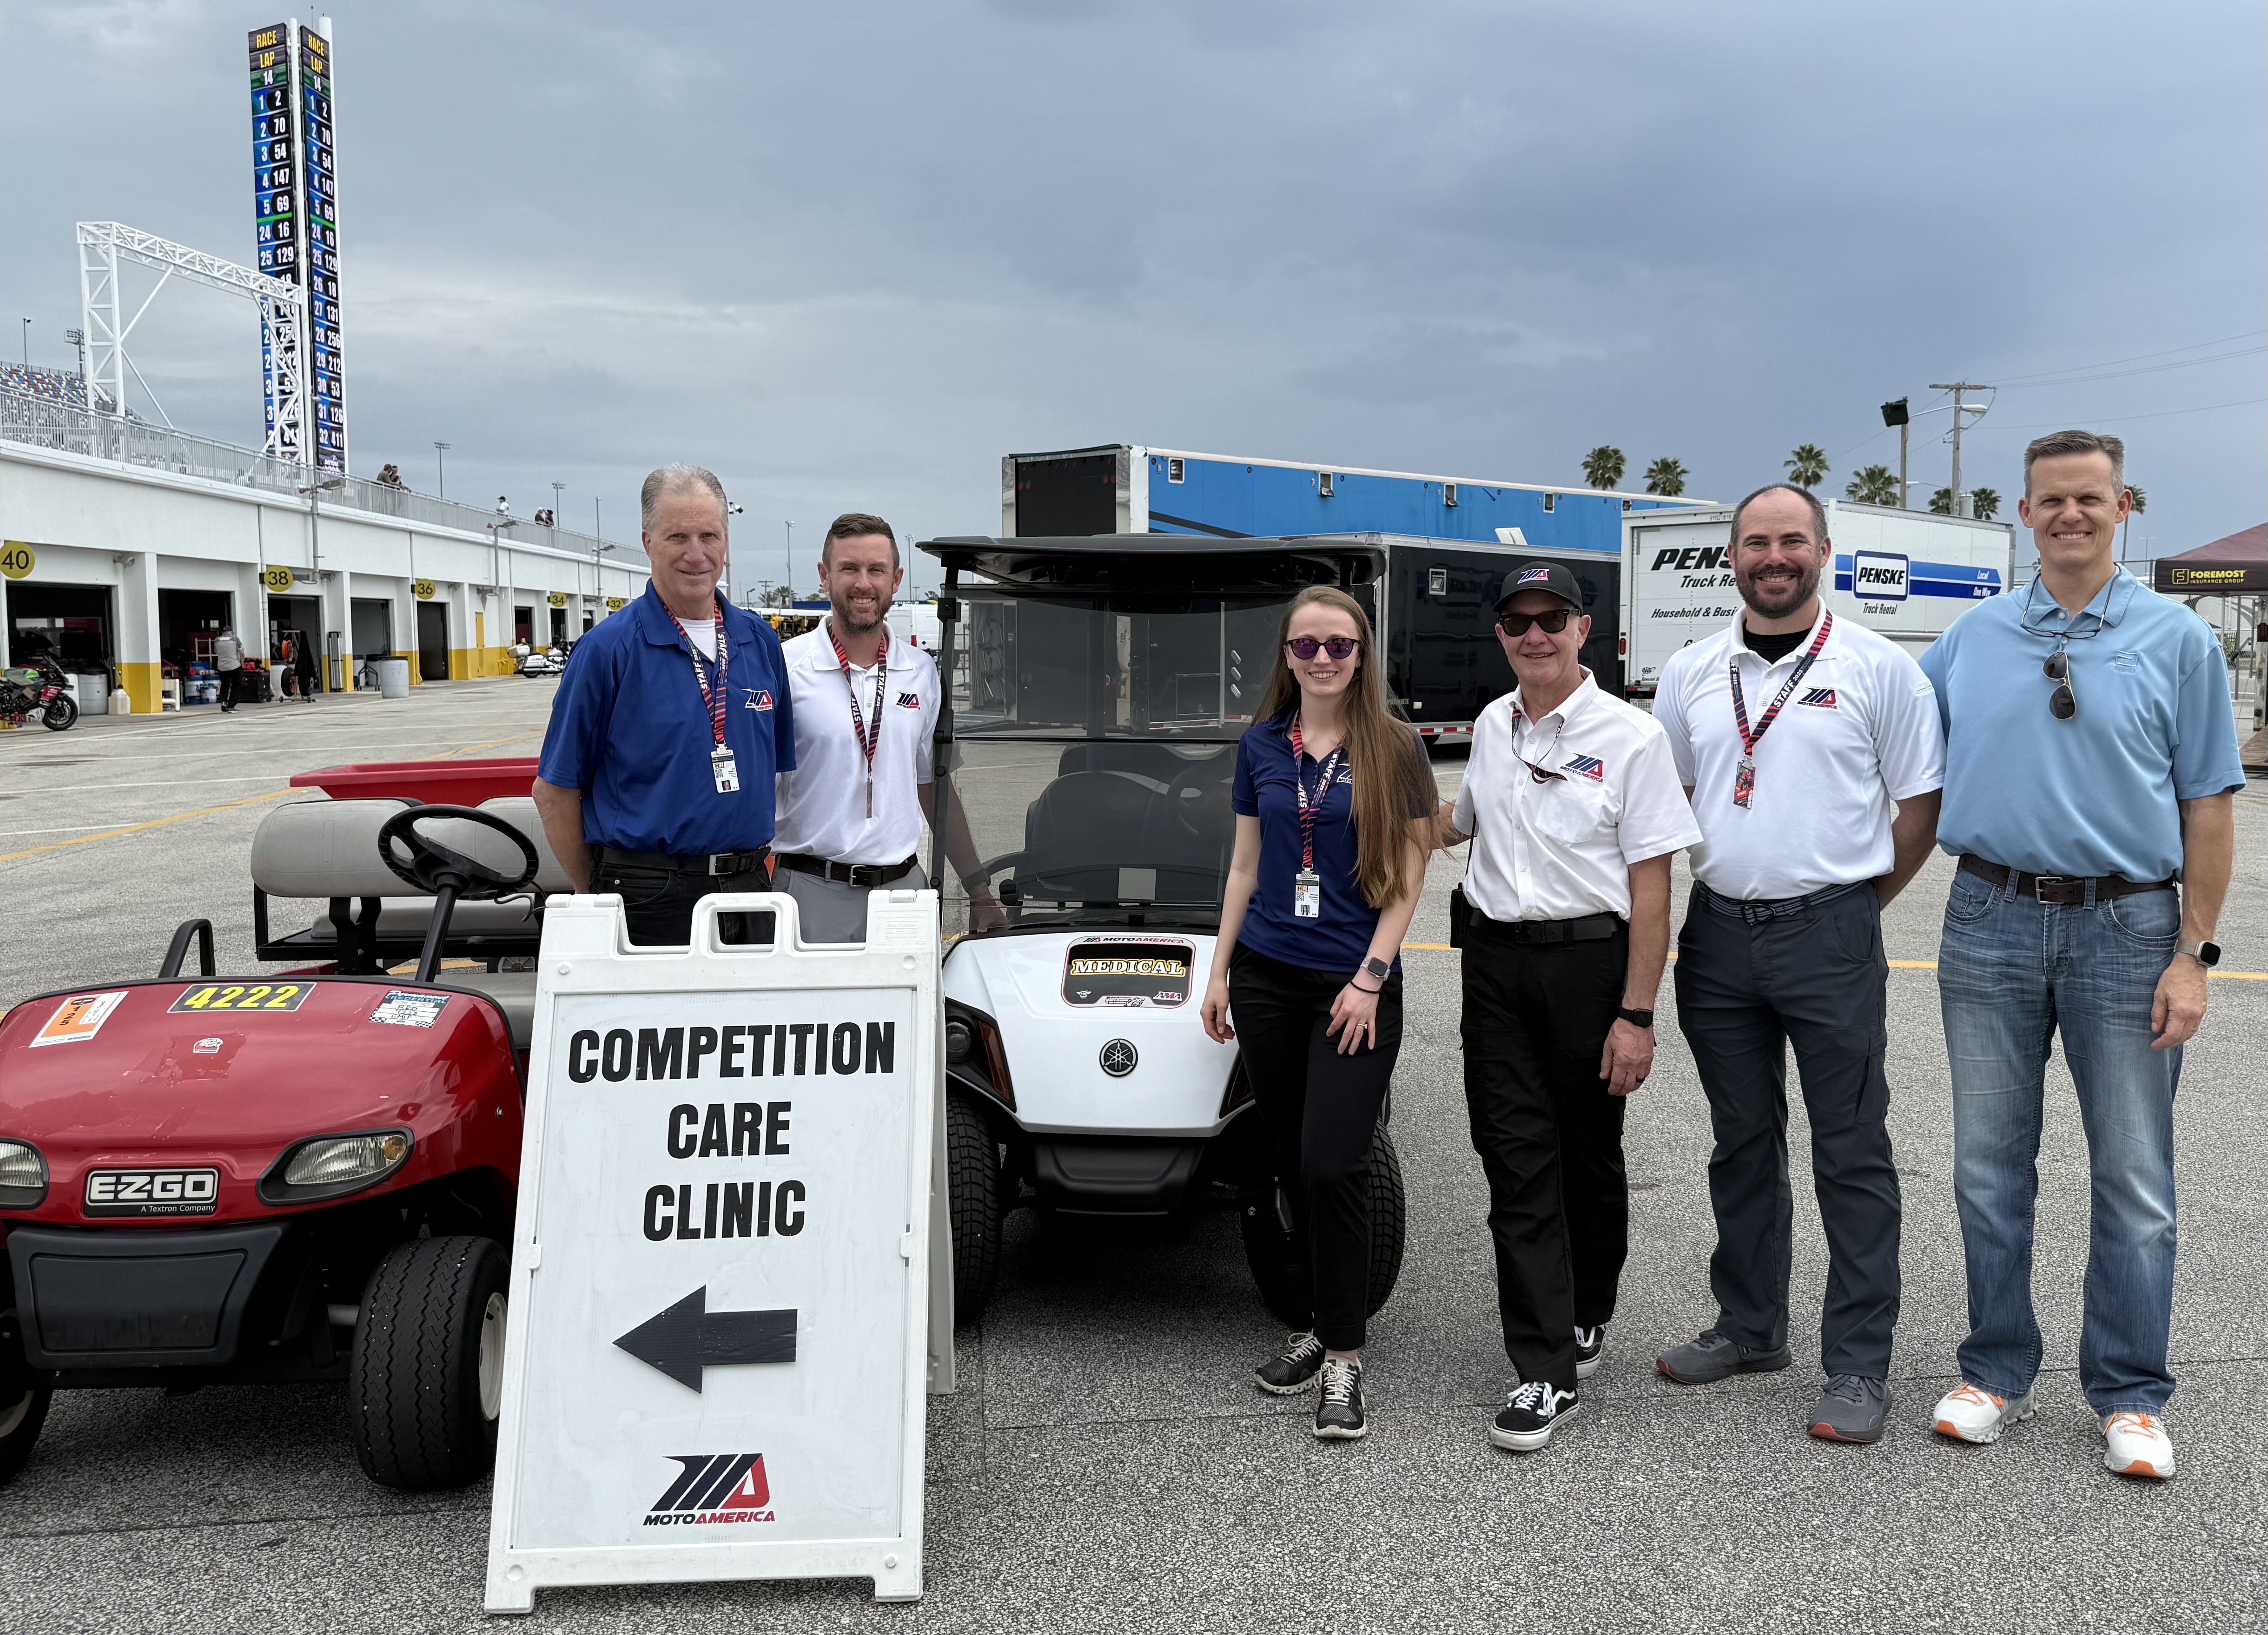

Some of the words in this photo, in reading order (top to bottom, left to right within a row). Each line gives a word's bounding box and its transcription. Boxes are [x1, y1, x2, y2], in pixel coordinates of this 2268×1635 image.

[257, 31, 277, 48] RACE
[309, 34, 324, 56] RACE
[260, 51, 275, 68] LAP
[311, 56, 323, 74] LAP
[264, 70, 273, 85] 14
[313, 75, 321, 92] 14
[259, 95, 264, 110] 1
[275, 91, 281, 106] 2
[311, 95, 314, 110] 1
[323, 102, 327, 118] 2
[261, 122, 266, 138] 2
[274, 117, 285, 134] 70
[312, 122, 316, 138] 2
[322, 127, 331, 145] 70
[261, 146, 267, 161] 3
[274, 143, 287, 160] 54
[313, 146, 317, 162] 3
[323, 152, 331, 171] 54
[263, 173, 268, 188] 4
[273, 168, 289, 185] 147
[314, 173, 319, 189] 4
[322, 177, 333, 196] 147
[264, 199, 270, 214] 5
[277, 195, 289, 211] 69
[315, 199, 320, 215] 5
[324, 204, 333, 221] 69
[259, 225, 271, 241] 24
[278, 221, 289, 238] 16
[312, 224, 321, 240] 24
[325, 230, 334, 247] 16
[260, 251, 272, 266] 25
[277, 246, 294, 264] 129
[313, 249, 322, 265] 25
[325, 254, 337, 272] 129
[314, 276, 323, 292] 26
[328, 281, 336, 297] 18
[315, 300, 323, 316] 27
[327, 305, 339, 323] 131
[316, 326, 324, 343] 28
[327, 330, 340, 348] 256
[317, 352, 325, 368] 29
[328, 356, 341, 373] 212
[317, 378, 326, 393] 30
[331, 381, 340, 397] 53
[318, 403, 327, 419] 31
[331, 407, 343, 423] 126
[319, 429, 328, 444] 32
[331, 431, 344, 448] 411
[1, 550, 29, 569] 40
[1651, 547, 1732, 571] PENS
[268, 571, 288, 585] 38
[1680, 575, 1717, 587] Truck
[1858, 567, 1905, 585] PENSKE
[1977, 570, 1989, 580] Local
[2190, 570, 2245, 579] FOREMOST
[418, 583, 433, 594] 36
[552, 595, 564, 604] 34
[1863, 603, 1878, 614] Truck
[1878, 604, 1898, 614] Rental
[1651, 607, 1702, 618] Household
[1702, 607, 1710, 617] &
[718, 633, 727, 659] STAFF
[694, 662, 708, 689] STAFF
[1773, 679, 1795, 708] STAFF
[1792, 669, 1803, 681] 2025
[852, 697, 861, 721] STAFF
[1322, 753, 1338, 779] STAFF
[1072, 959, 1185, 976] MEDICAL
[184, 986, 299, 1008] 4222
[569, 1022, 895, 1083] COMPETITION
[668, 1101, 791, 1159] CARE
[643, 1180, 806, 1241] CLINIC
[643, 1511, 775, 1526] MOTOAMERICA
